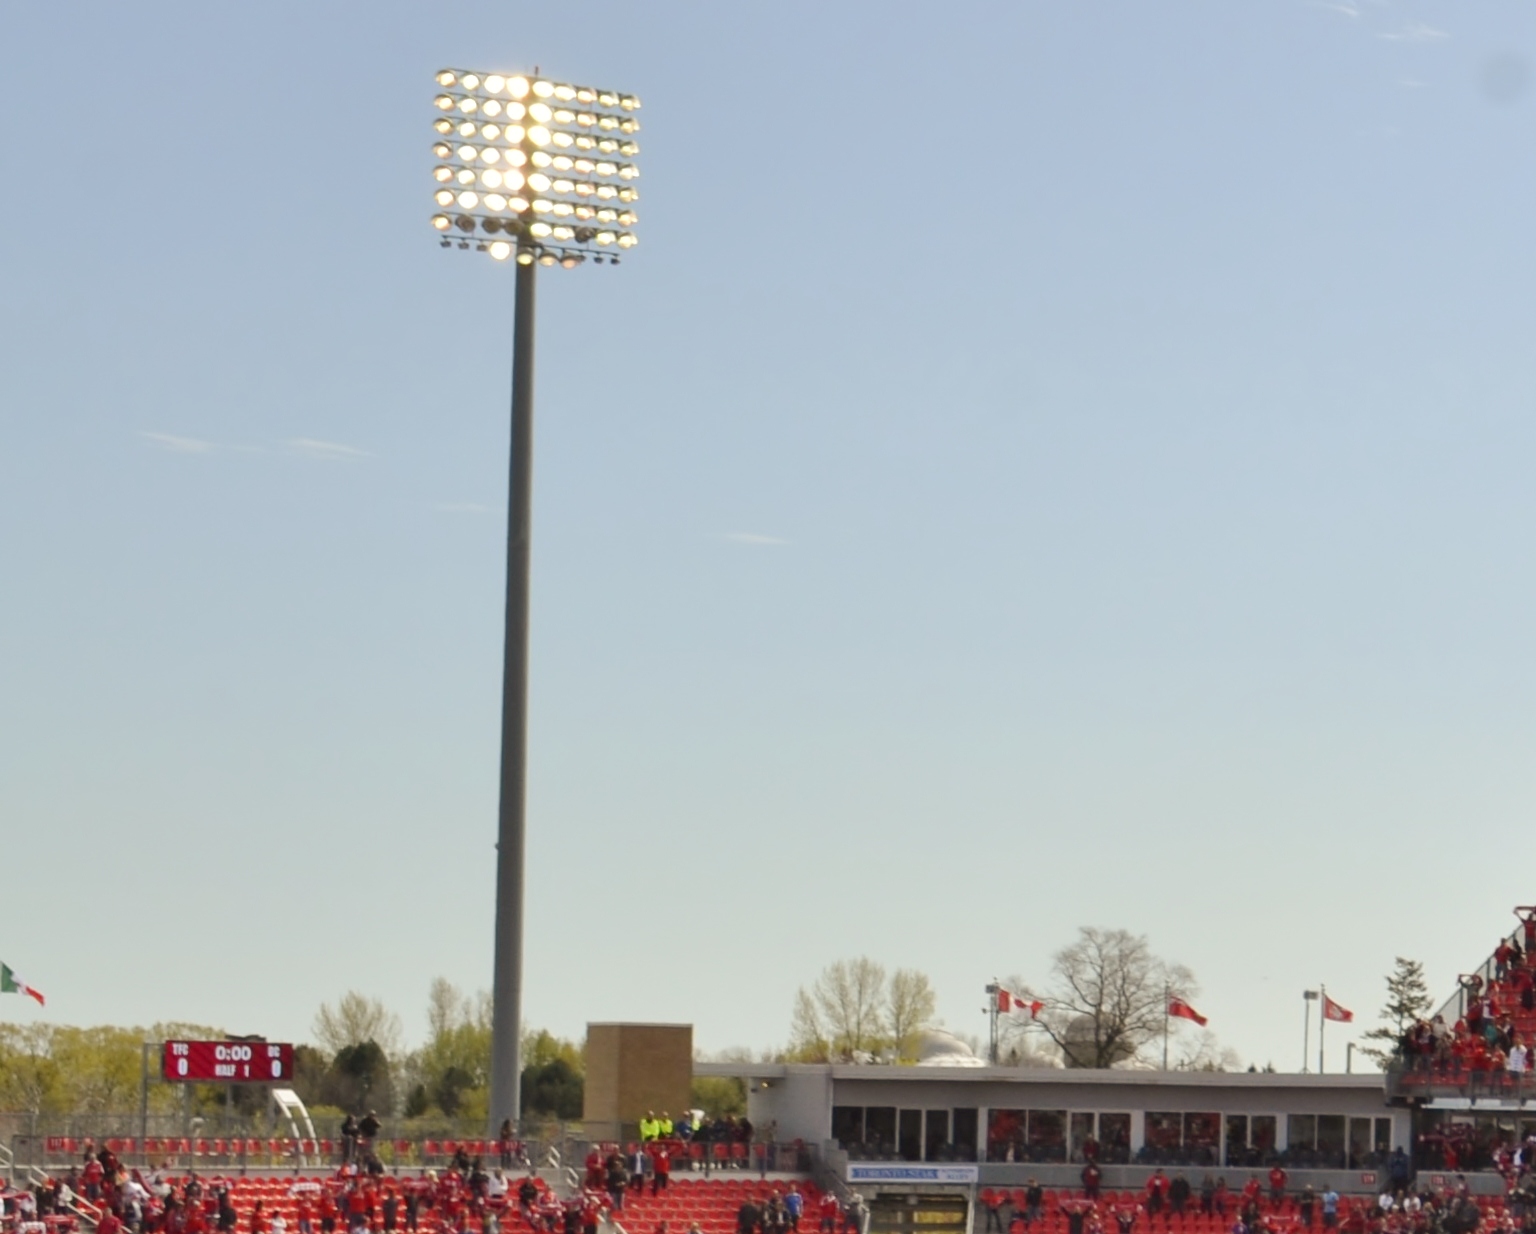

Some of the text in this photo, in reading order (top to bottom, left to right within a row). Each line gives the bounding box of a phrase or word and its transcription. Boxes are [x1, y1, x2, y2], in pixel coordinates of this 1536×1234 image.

[215, 1045, 252, 1061] 0:00
[177, 1058, 188, 1076] 0
[271, 1060, 282, 1078] 0
